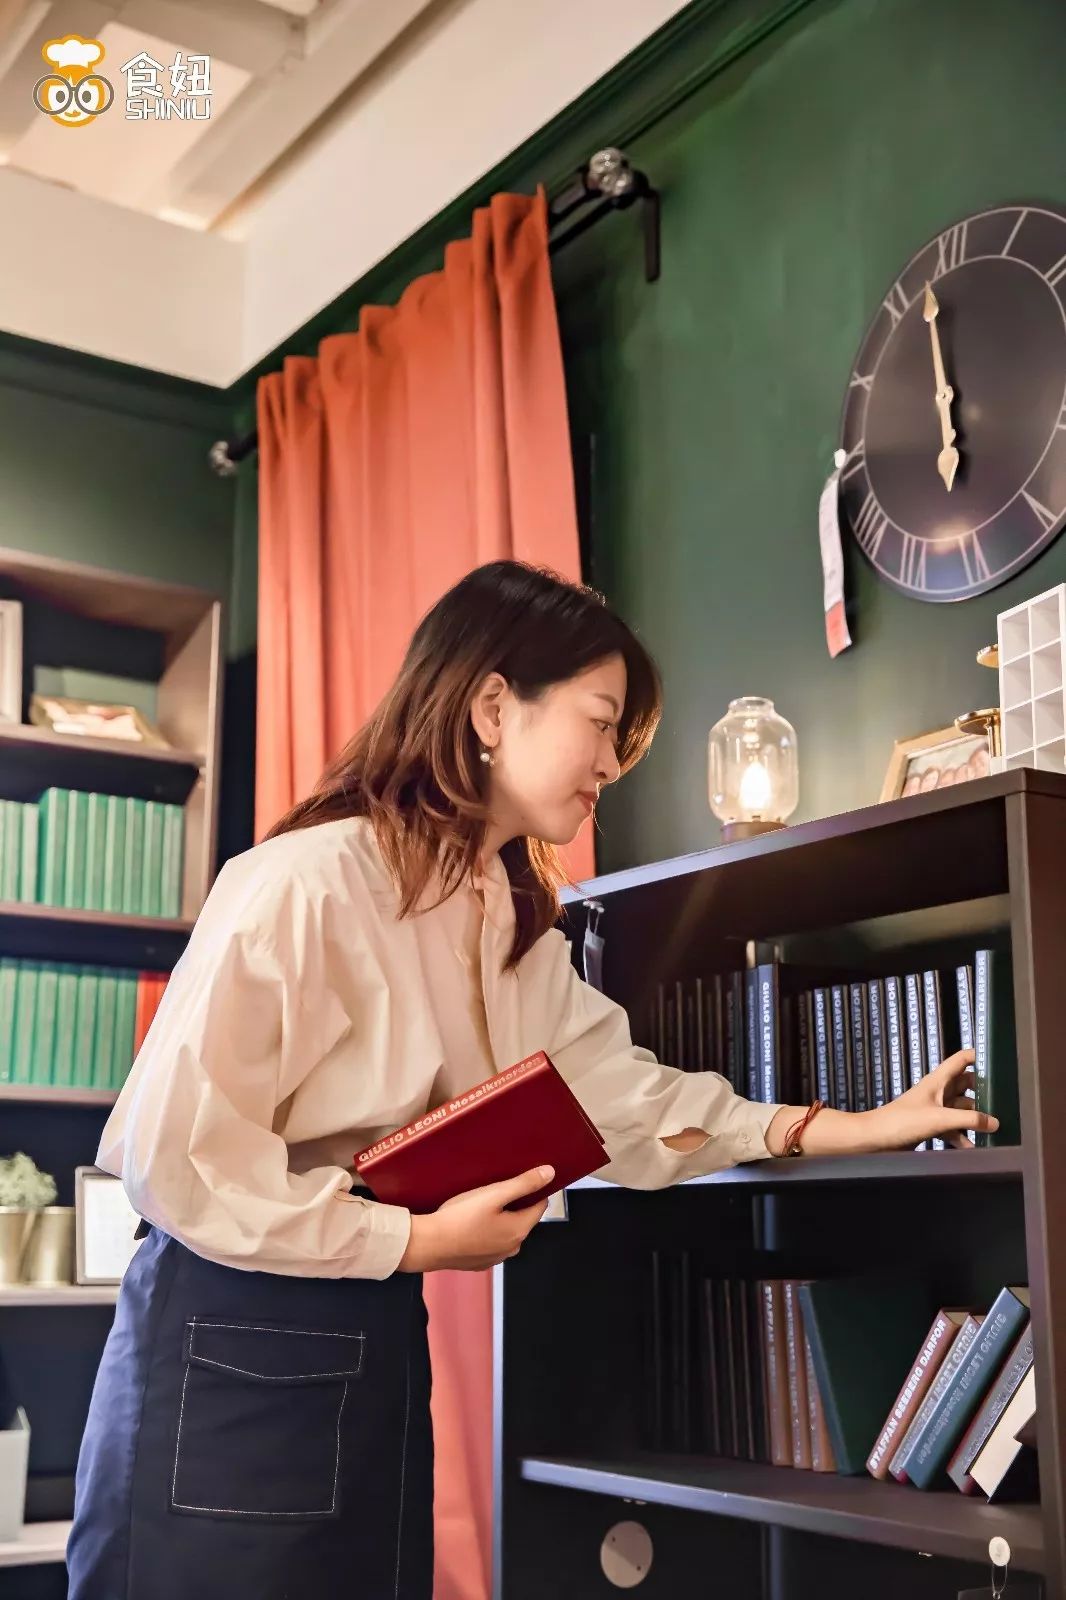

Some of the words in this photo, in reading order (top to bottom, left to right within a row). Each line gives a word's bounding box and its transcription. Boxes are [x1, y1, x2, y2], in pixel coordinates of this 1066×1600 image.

[762, 982, 770, 1023] GIULIO
[871, 985, 880, 1035] DARFOR
[888, 983, 897, 1033] DARFOR
[927, 976, 937, 1034] STAFFAN
[958, 972, 969, 1030] STAFFAN
[977, 957, 985, 1011] DARFOR
[763, 1026, 771, 1062] LEONI
[816, 993, 825, 1042] DARFOR
[911, 1024, 919, 1063] LEONI
[873, 1039, 883, 1097] SEEBERG
[891, 1036, 901, 1095] SEEBERG
[977, 1016, 985, 1078] SEEBERG
[358, 1133, 404, 1163] GIULIO
[406, 1108, 447, 1136] LEONI
[869, 1420, 899, 1469] STAFFAN
[894, 1368, 924, 1419] SEEBERG
[920, 1319, 947, 1367] DARFOR
